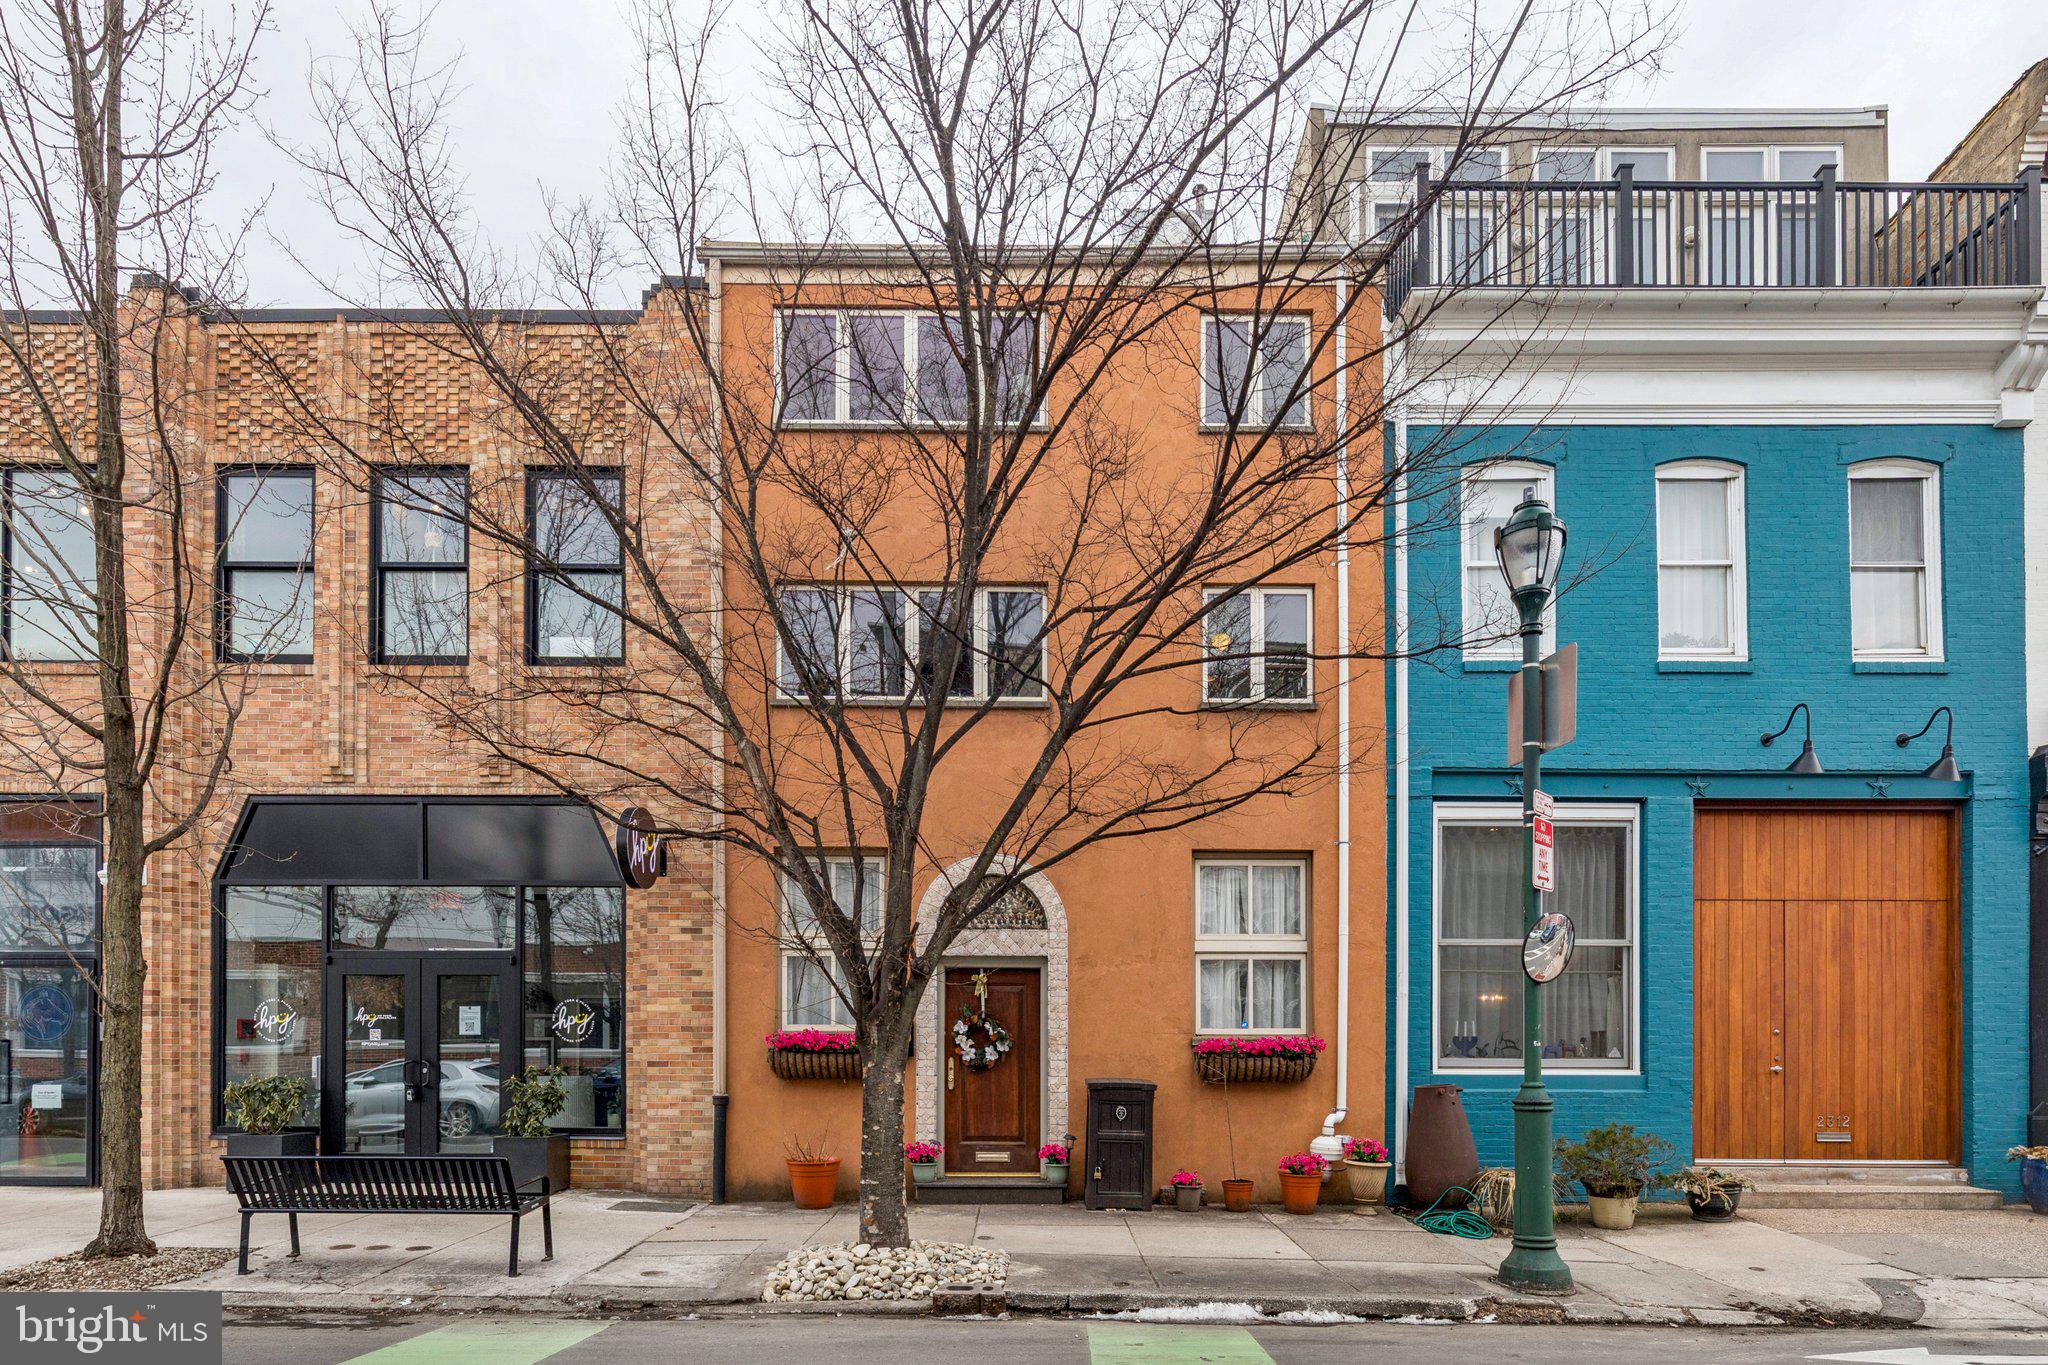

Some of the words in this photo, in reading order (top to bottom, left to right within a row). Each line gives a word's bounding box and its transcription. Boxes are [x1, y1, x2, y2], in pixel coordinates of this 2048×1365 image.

[1536, 831, 1551, 845] STOPPING
[1538, 848, 1548, 860] ANY
[1538, 860, 1548, 873] TIME
[253, 1005, 297, 1034] hpy
[354, 1006, 378, 1028] hpy
[552, 1006, 596, 1034] hpy
[1817, 1115, 1850, 1128] 2312
